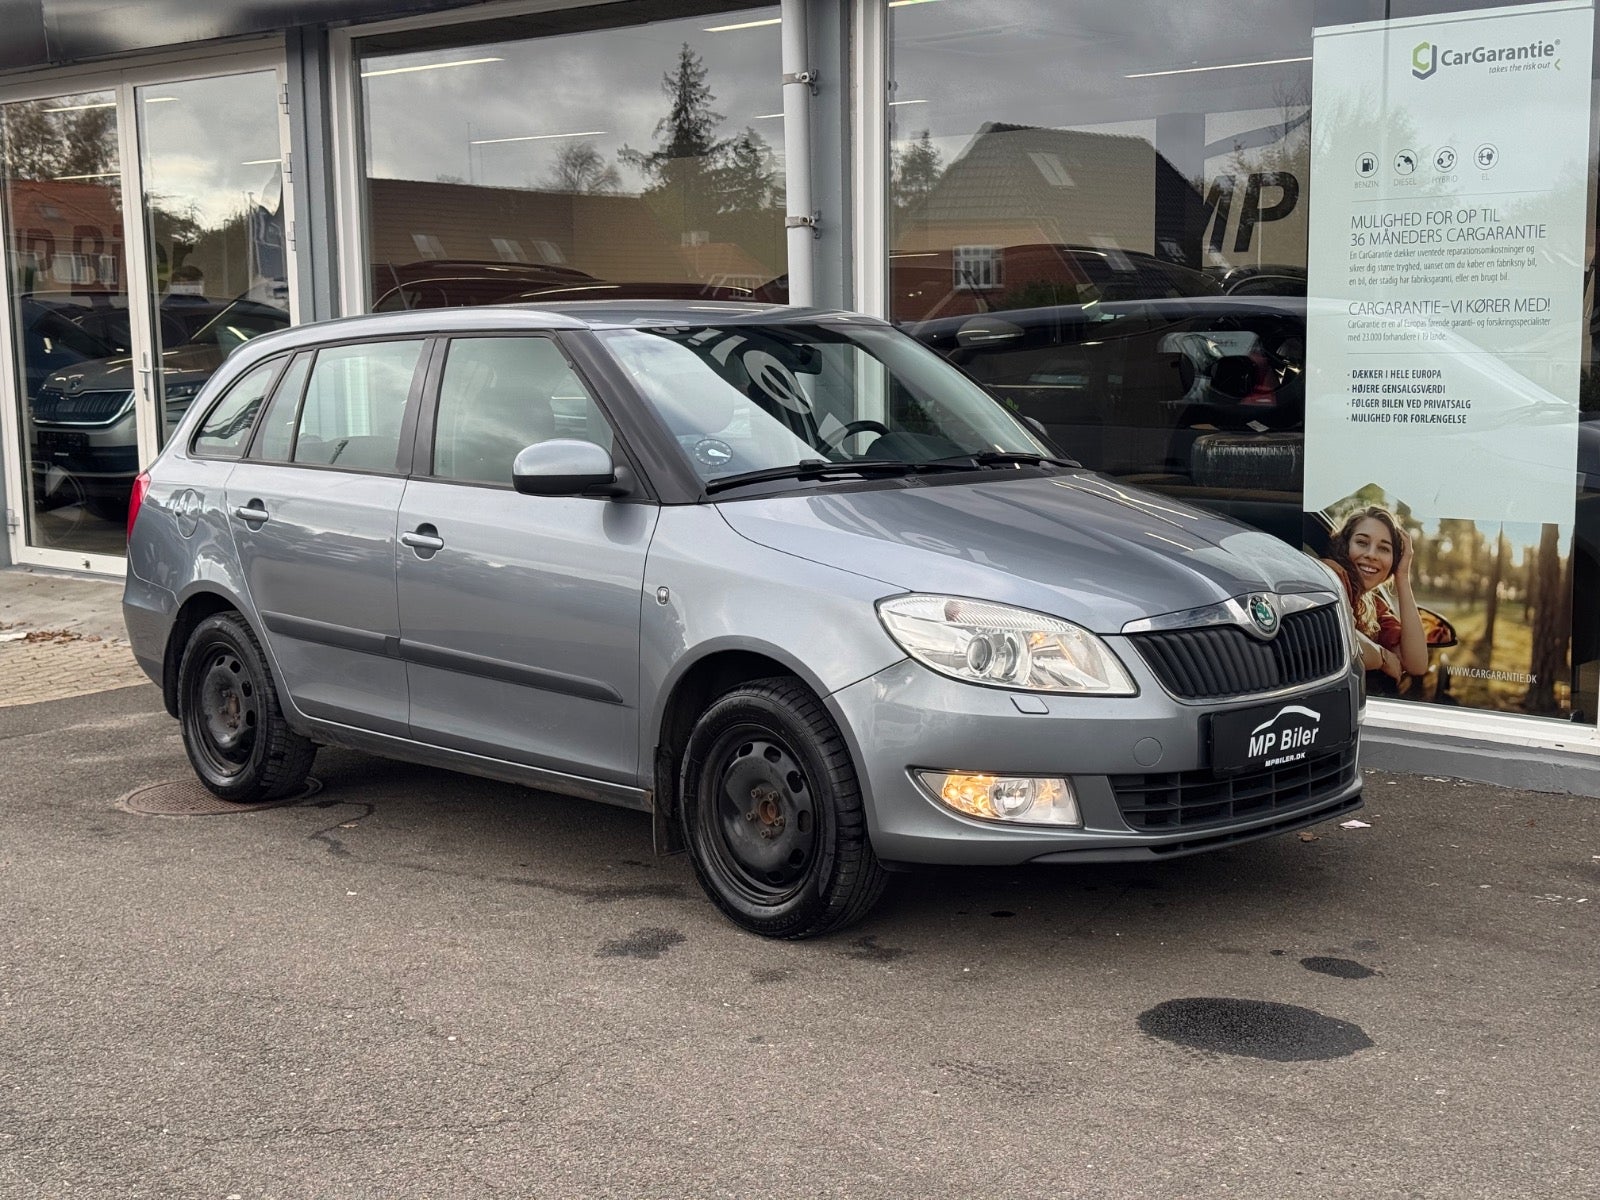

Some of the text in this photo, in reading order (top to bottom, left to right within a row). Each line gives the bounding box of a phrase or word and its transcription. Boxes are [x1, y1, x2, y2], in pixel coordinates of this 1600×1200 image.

[1489, 62, 1551, 74] takes the risk out
[1354, 180, 1379, 189] BENZIN
[1393, 178, 1416, 187] DIESEL
[1351, 208, 1501, 229] MULIGHED FOR OP TIL
[1351, 224, 1547, 247] 36 MÅNEDERS CARGARANTIE
[1359, 249, 1392, 260] CarGarantie
[1394, 248, 1416, 258] dækker
[1417, 247, 1445, 257] uventede
[1446, 245, 1524, 257] reparationsomkostninger
[1526, 245, 1535, 255] og
[1366, 263, 1376, 274] dig
[1396, 262, 1422, 273] tryghed,
[1423, 262, 1443, 270] uanset
[1444, 261, 1455, 269] om
[1456, 260, 1465, 269] du
[1466, 259, 1485, 269] køber
[1486, 260, 1494, 268] en
[1496, 258, 1526, 269] fabriksny
[1528, 257, 1538, 268] bil,
[1349, 278, 1356, 286] en
[1368, 276, 1378, 285] der
[1380, 276, 1398, 287] stadig
[1400, 275, 1409, 284] har
[1455, 273, 1471, 283] eller
[1471, 274, 1478, 282] en
[1480, 272, 1498, 284] brugt
[1466, 298, 1511, 313] KØRER
[1514, 298, 1551, 312] MED!
[1348, 319, 1380, 329] CarGarantie
[1450, 318, 1475, 329] garanti-
[1476, 318, 1484, 328] og
[1348, 332, 1360, 342] med
[1352, 369, 1383, 379] DÆKKER
[1390, 369, 1410, 379] HELE
[1411, 369, 1442, 379] EUROPA
[1352, 384, 1446, 394] HØJERE GENSALGSVÆRDI
[1351, 398, 1472, 409] FØLGER BILEN VED PRIVATSALG
[1351, 413, 1467, 424] MULIGHED FOR FORLÆNGELSE
[1446, 666, 1537, 684] WWW.CARGARANTIE.DK
[1248, 726, 1319, 758] MP Biler
[1265, 752, 1306, 768] MPBILER.DK
